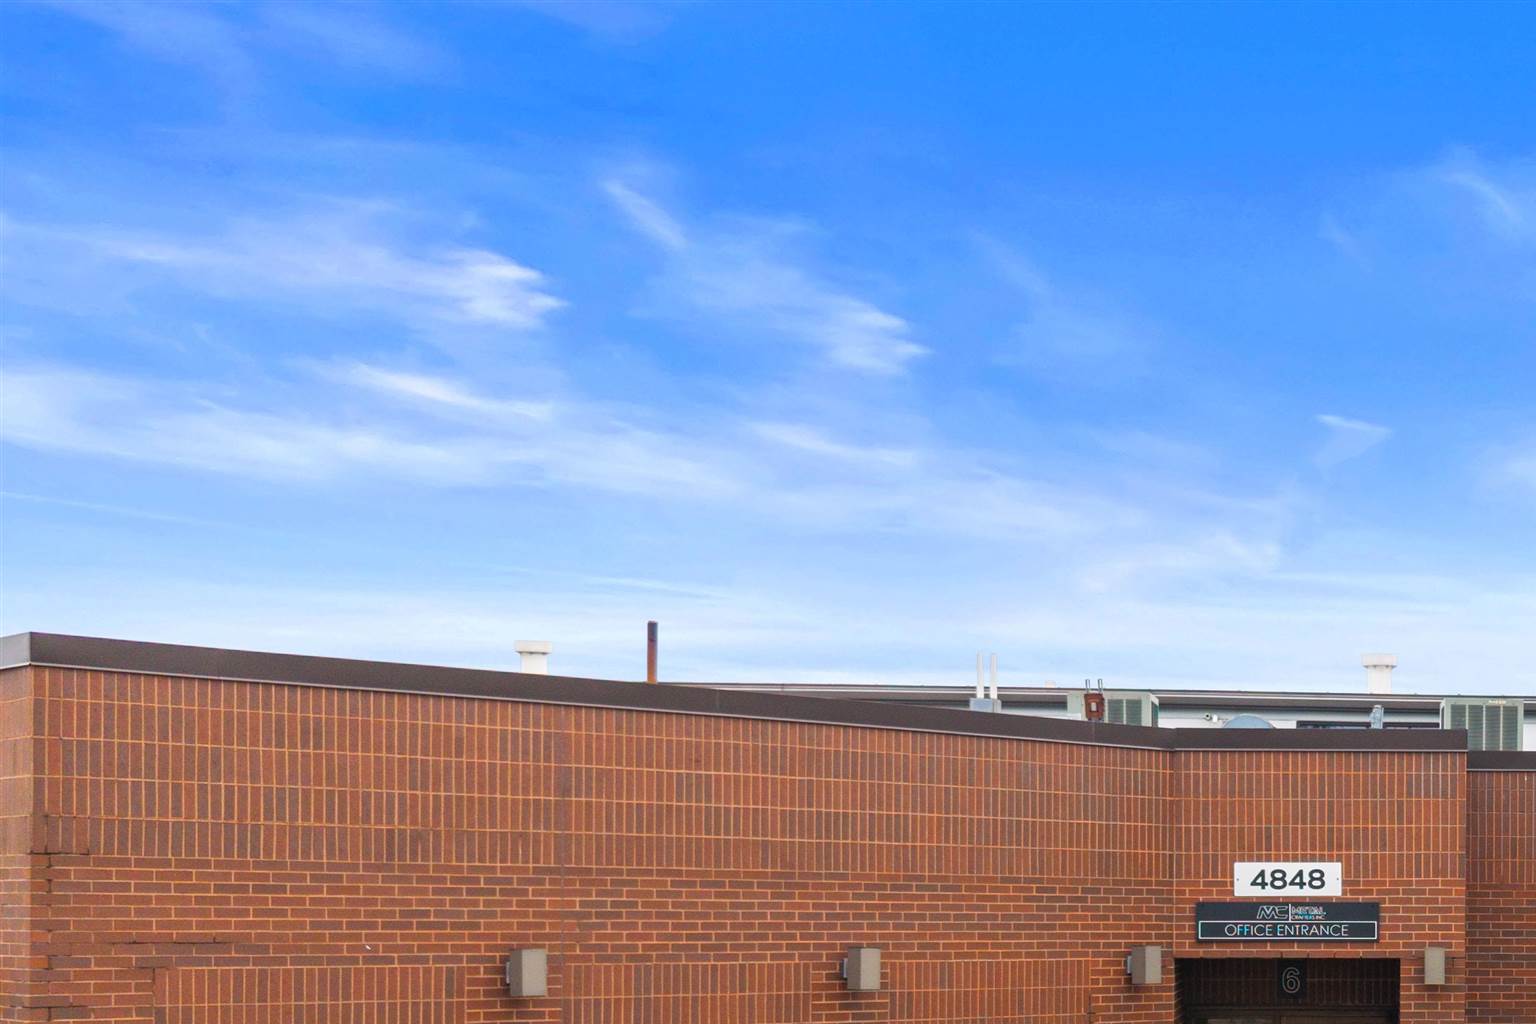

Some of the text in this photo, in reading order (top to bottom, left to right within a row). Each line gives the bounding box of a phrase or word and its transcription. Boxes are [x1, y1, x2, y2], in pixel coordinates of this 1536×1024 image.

[1250, 869, 1326, 889] 4848
[1224, 924, 1349, 936] OFFICE ENTRANCE
[1281, 966, 1301, 993] 6
